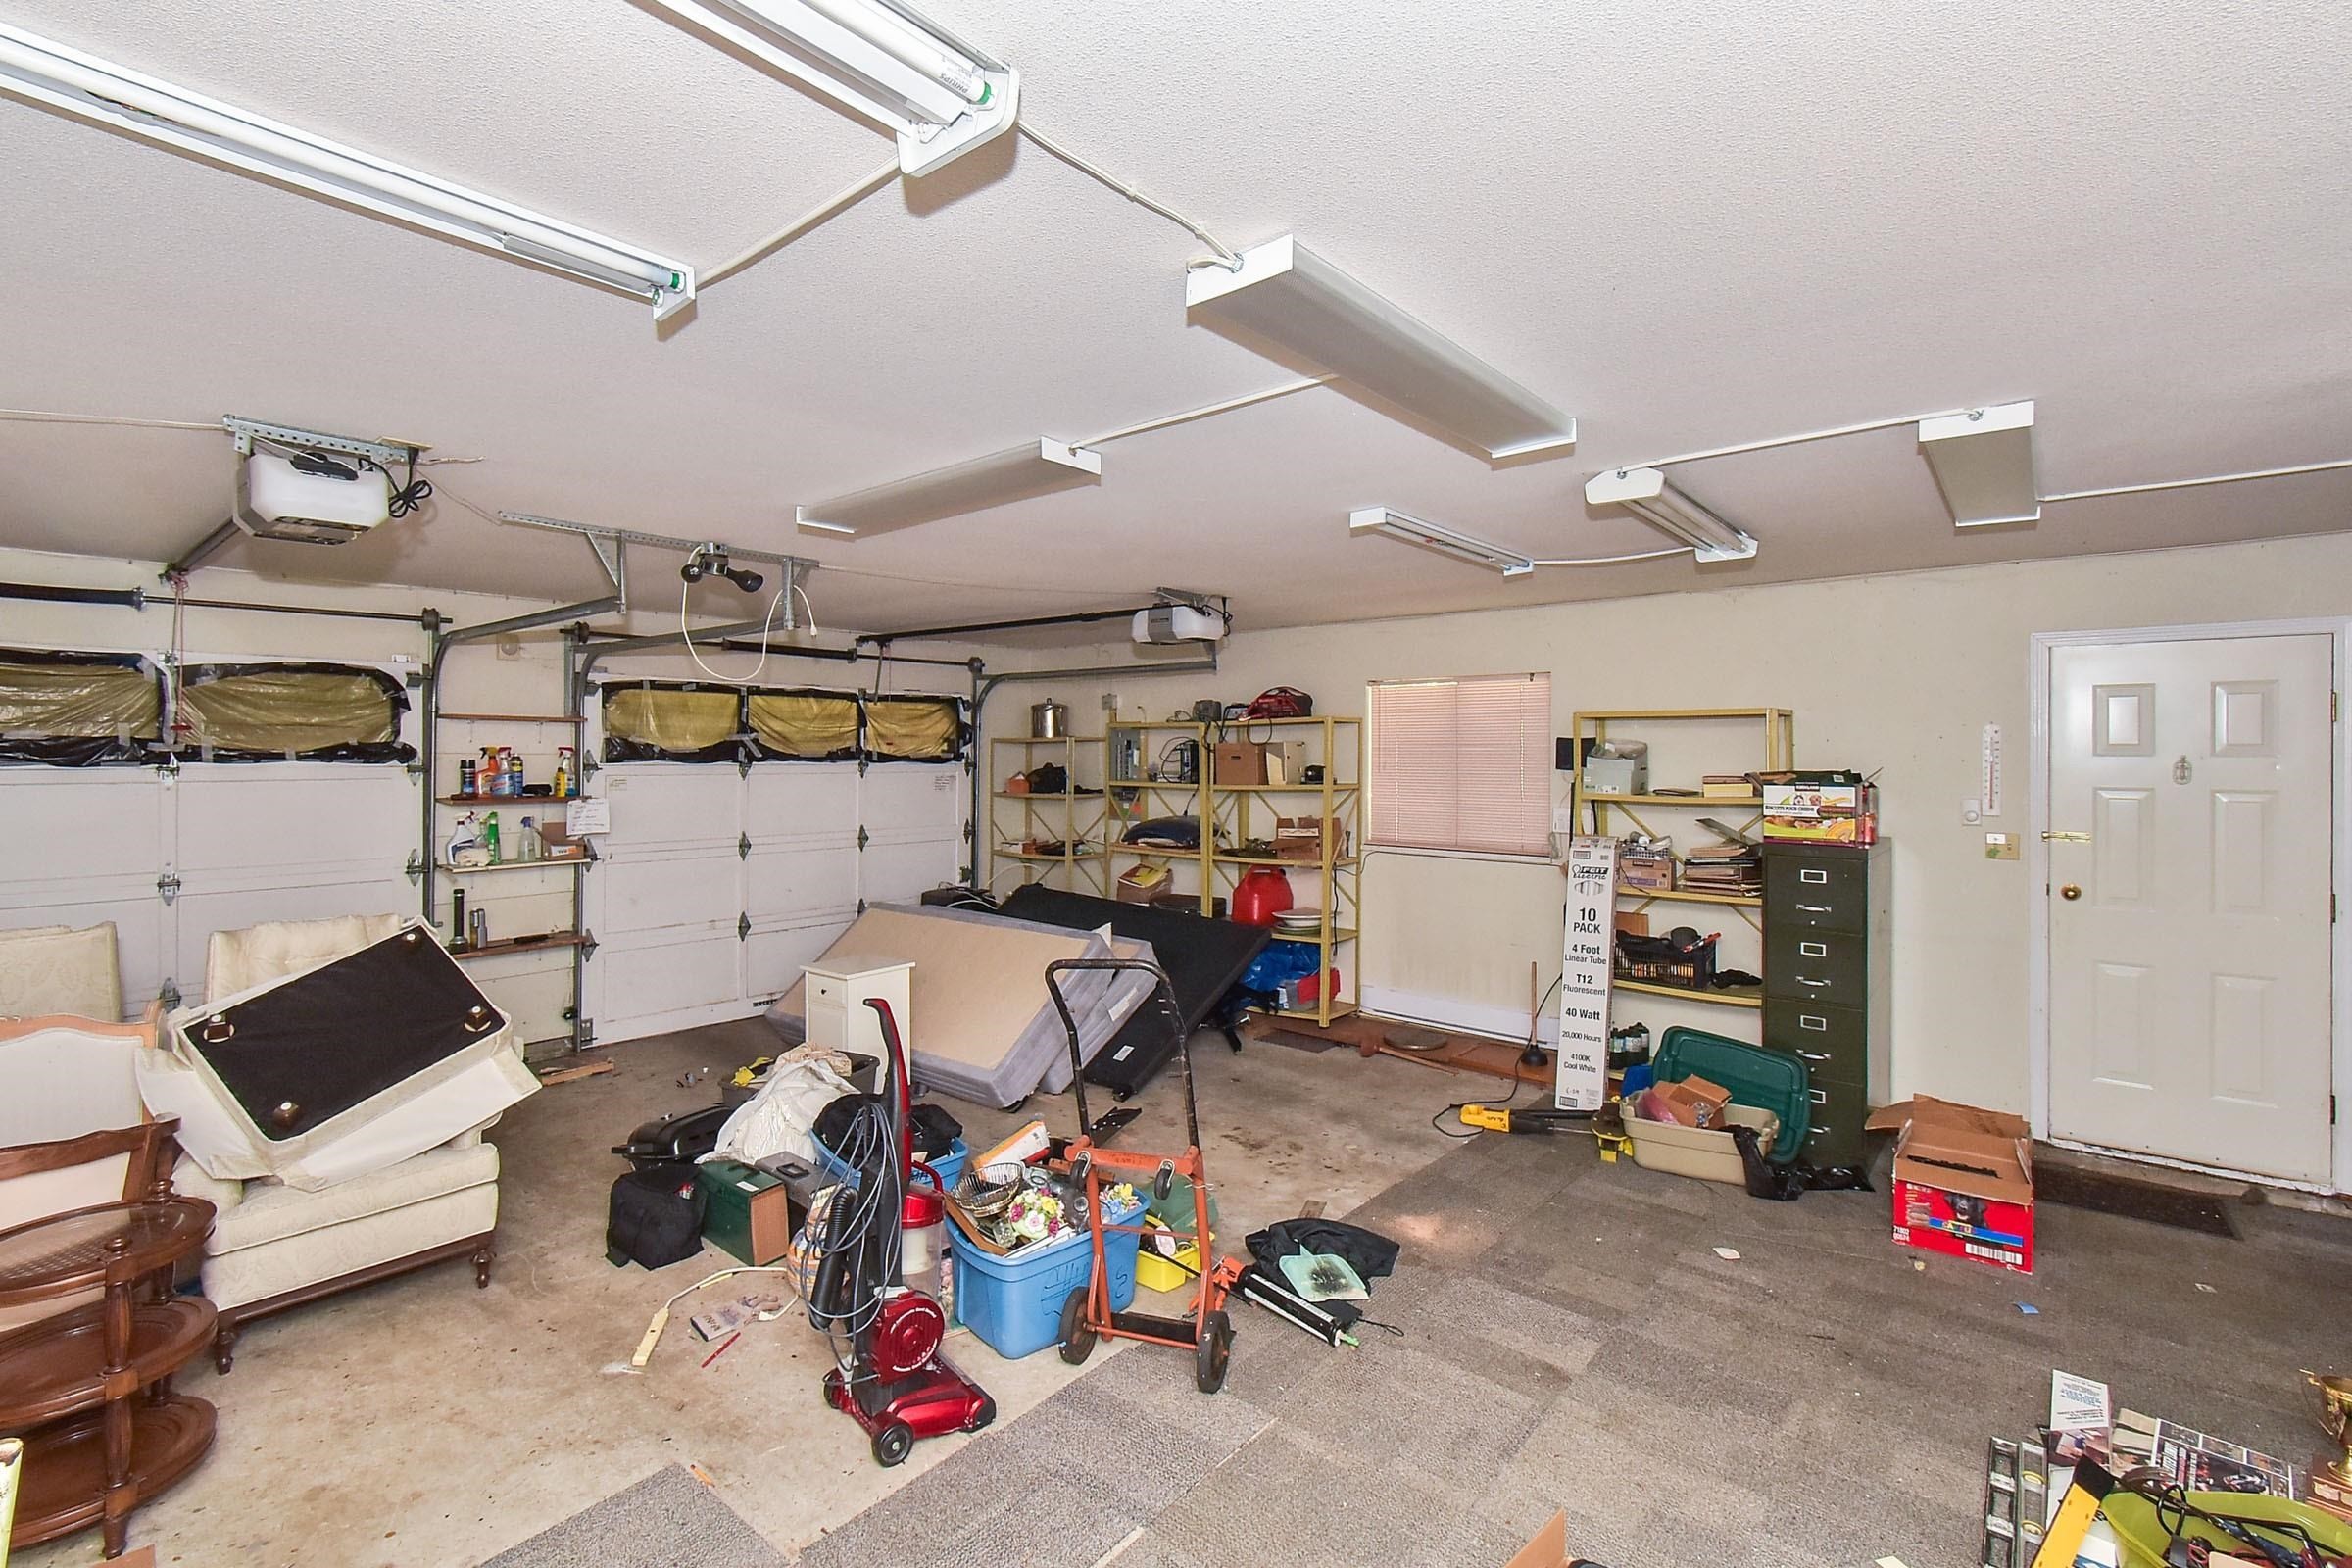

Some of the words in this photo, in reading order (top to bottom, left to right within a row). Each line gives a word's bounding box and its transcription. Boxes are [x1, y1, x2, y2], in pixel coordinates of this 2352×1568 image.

[940, 74, 969, 94] PHILIPS
[1579, 907, 1596, 922] 10
[1573, 922, 1601, 934] PACK
[1572, 944, 1578, 953] 4
[1581, 945, 1600, 955] Foot
[1590, 956, 1607, 965] Tube
[1576, 974, 1592, 984] T12
[1563, 984, 1606, 996] Fluorescent
[1565, 1007, 1577, 1017] 40
[1579, 1009, 1600, 1020] Watt
[1561, 1030, 1583, 1040] 20,000
[1583, 1033, 1601, 1043] Hours
[1570, 1053, 1591, 1062] 4100K
[1578, 1063, 1597, 1073] White
